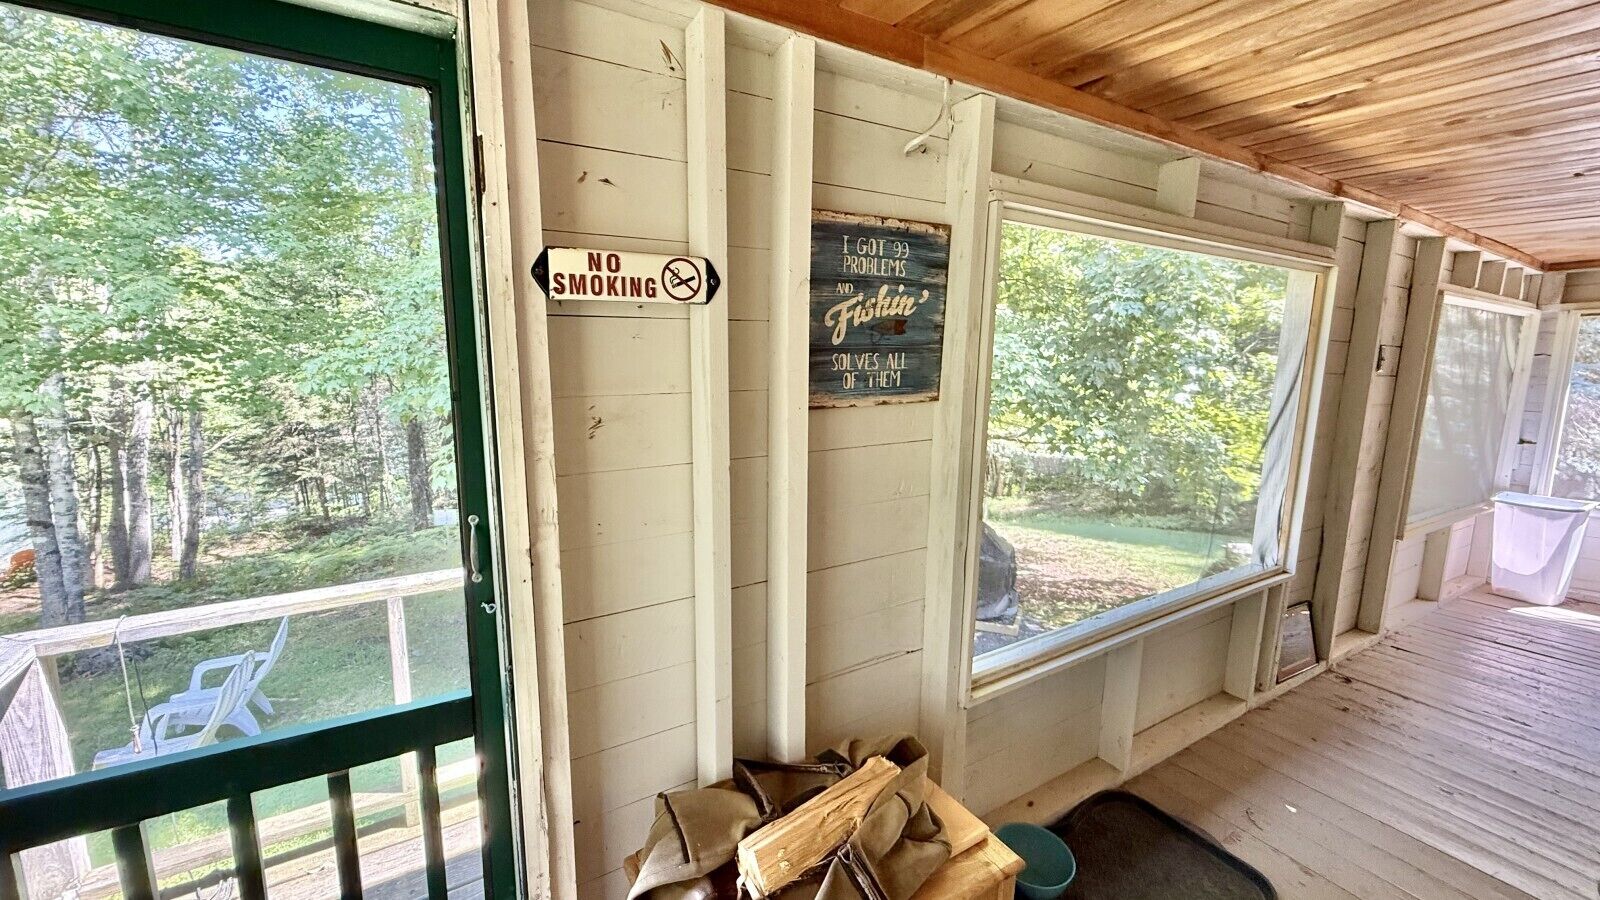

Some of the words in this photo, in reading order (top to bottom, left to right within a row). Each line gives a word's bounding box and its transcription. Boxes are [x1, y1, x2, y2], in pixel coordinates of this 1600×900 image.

[842, 235, 850, 254] I
[857, 237, 886, 256] GOT
[893, 241, 910, 259] 99
[587, 252, 621, 274] NO
[843, 255, 907, 277] PROBLEMS
[553, 272, 657, 298] SMOKING
[836, 282, 854, 294] AND
[824, 284, 930, 346] Fishin'
[831, 352, 880, 370] SOLVES
[886, 352, 908, 369] ALL
[843, 372, 859, 389] OF
[867, 370, 901, 388] THEM
